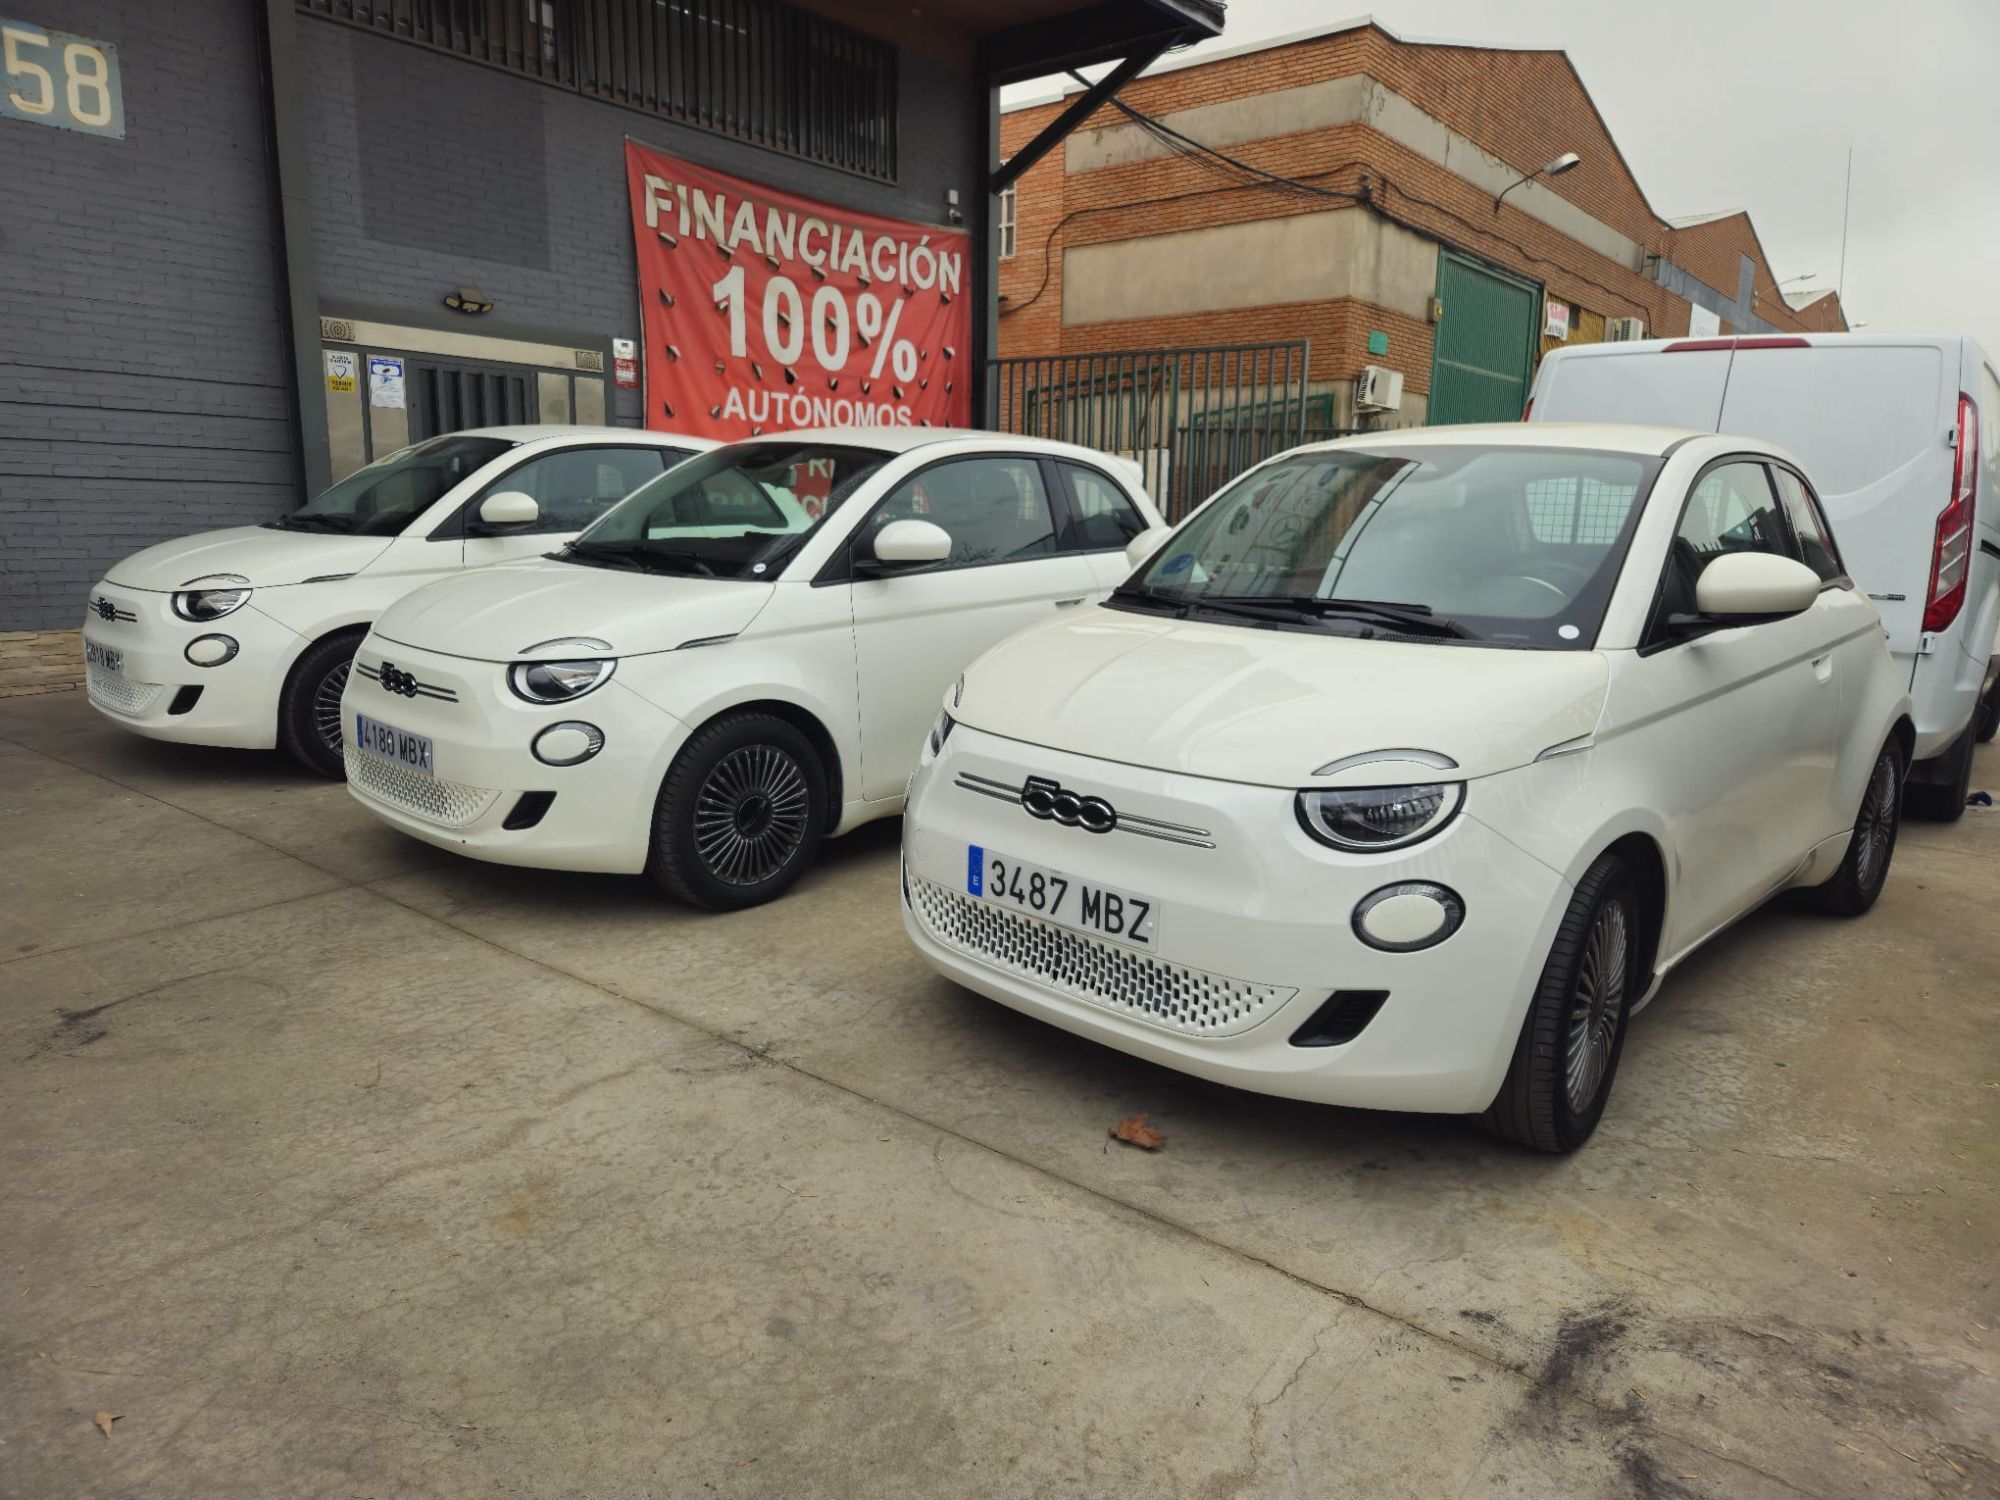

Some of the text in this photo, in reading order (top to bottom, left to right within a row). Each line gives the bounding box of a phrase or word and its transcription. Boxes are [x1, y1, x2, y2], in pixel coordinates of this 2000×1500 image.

[2, 26, 112, 126] 58
[644, 173, 961, 295] FINANCIACIÓN
[712, 265, 918, 383] 100%
[722, 386, 912, 428] AUTÓNOMOS
[364, 721, 428, 769] 4180 MBX
[1021, 775, 1118, 834] 500
[990, 859, 1068, 915] 3487
[1081, 885, 1151, 943] MBZ
